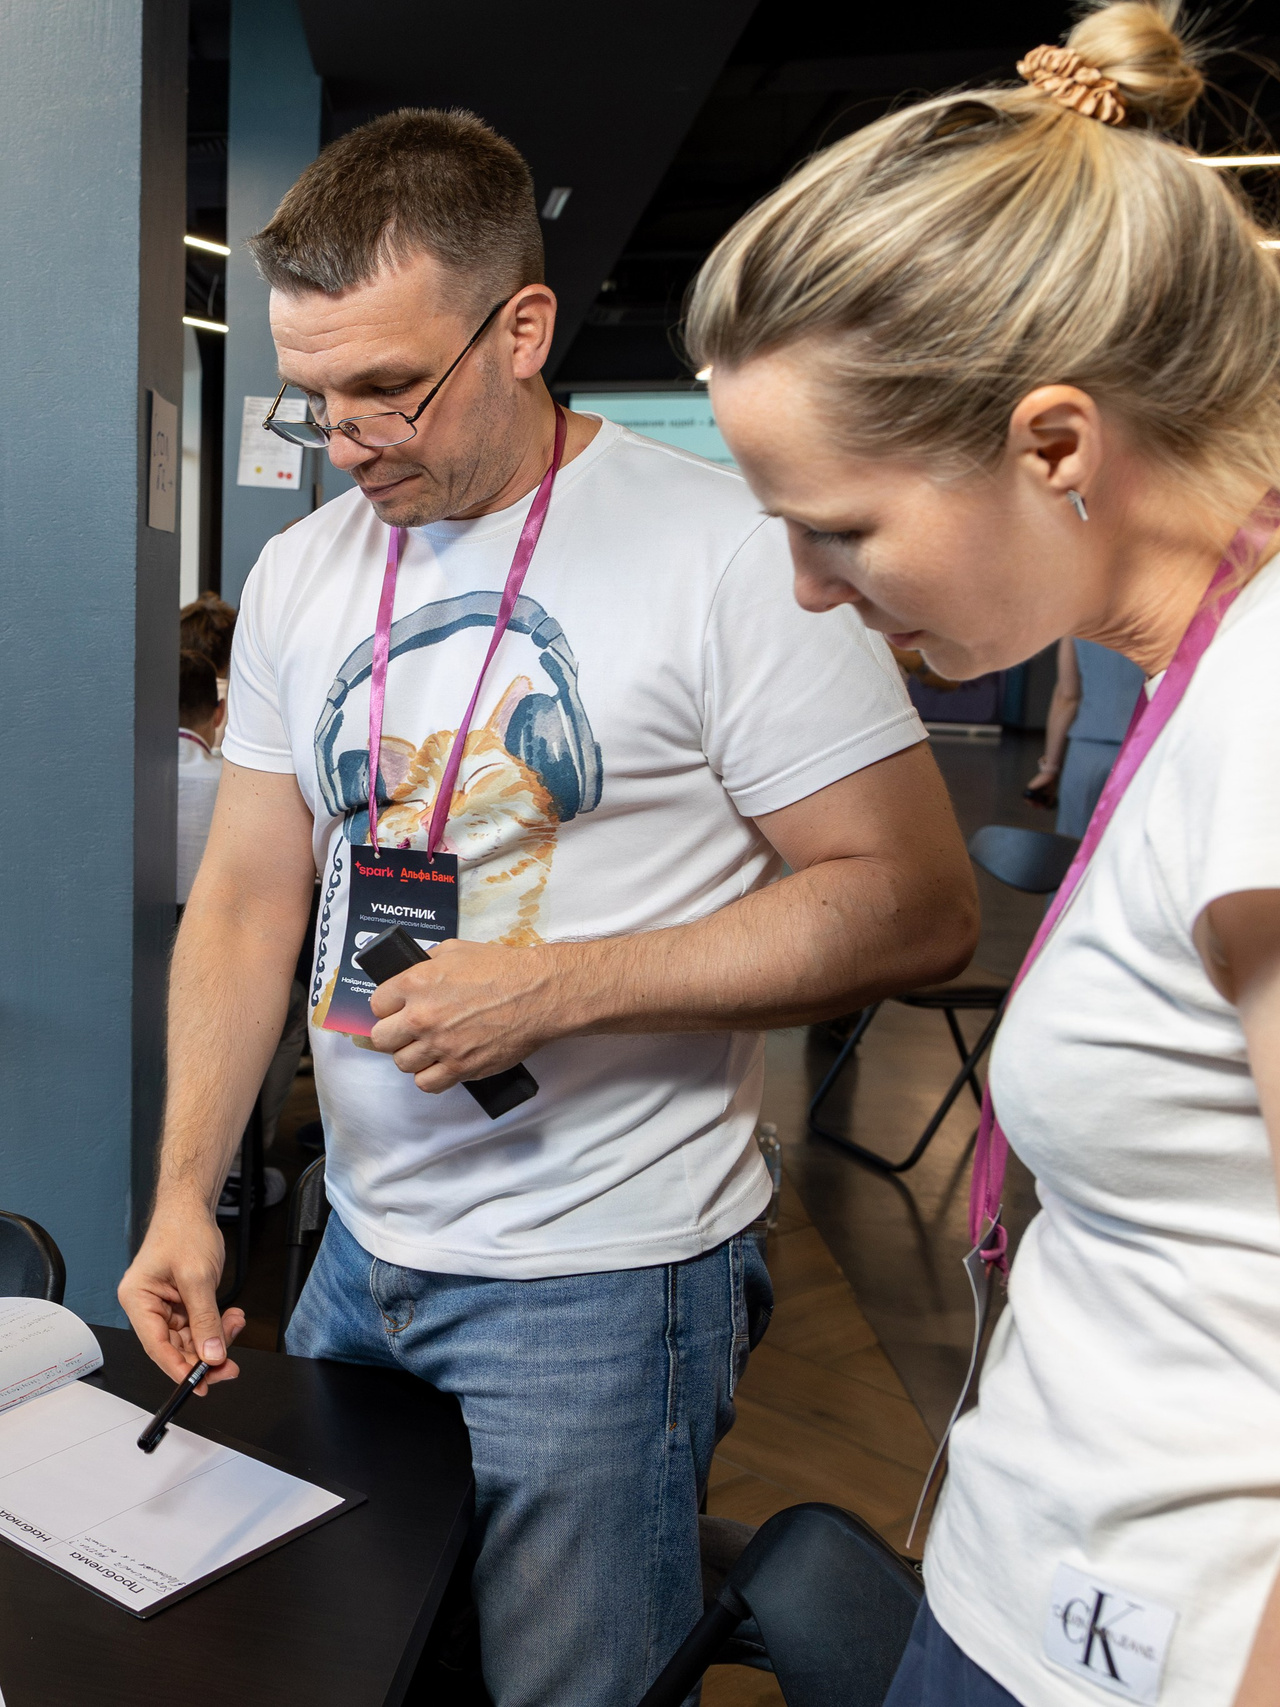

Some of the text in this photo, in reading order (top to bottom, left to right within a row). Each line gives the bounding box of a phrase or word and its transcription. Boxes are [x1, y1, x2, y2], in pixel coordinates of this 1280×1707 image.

[359, 866, 394, 878] spark
[400, 867, 455, 884] Альфа Банк
[359, 914, 396, 925] Креативной
[371, 902, 436, 920] УЧАСТНИК
[68, 1551, 145, 1597] Проблема
